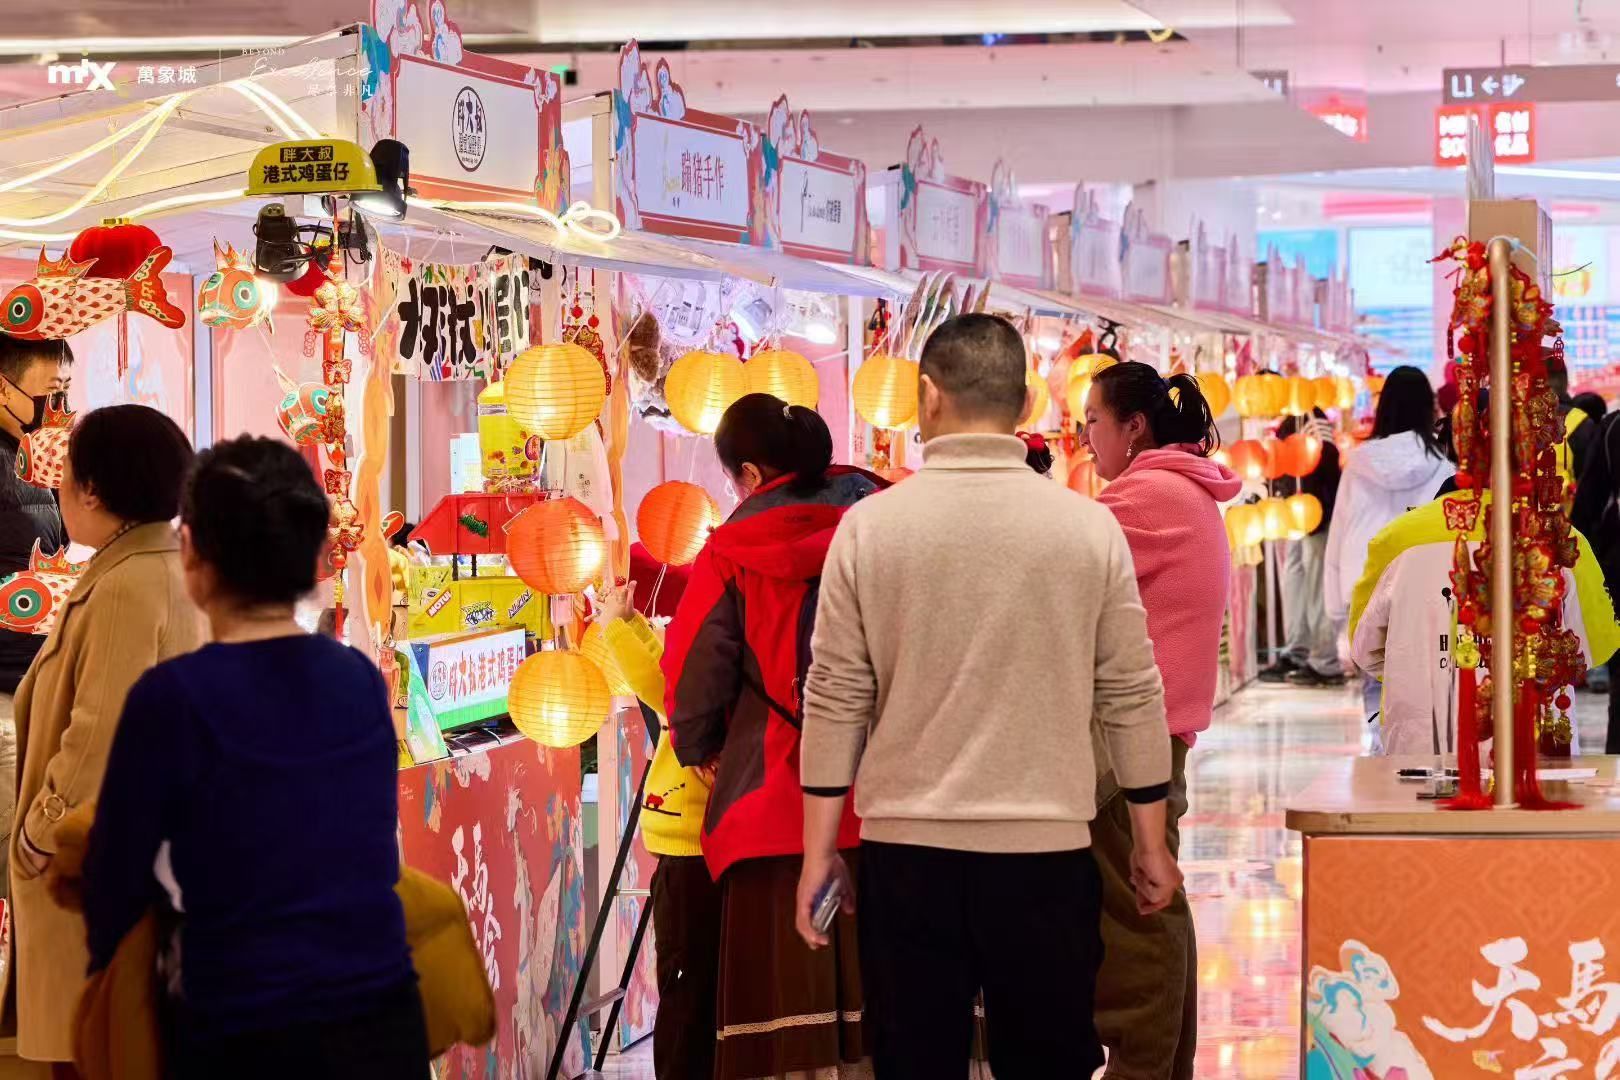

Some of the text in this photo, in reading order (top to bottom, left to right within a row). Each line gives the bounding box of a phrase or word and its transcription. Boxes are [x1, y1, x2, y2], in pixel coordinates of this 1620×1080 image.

[283, 147, 332, 161] 胖大叔
[263, 162, 350, 184] 港式鸡蛋仔
